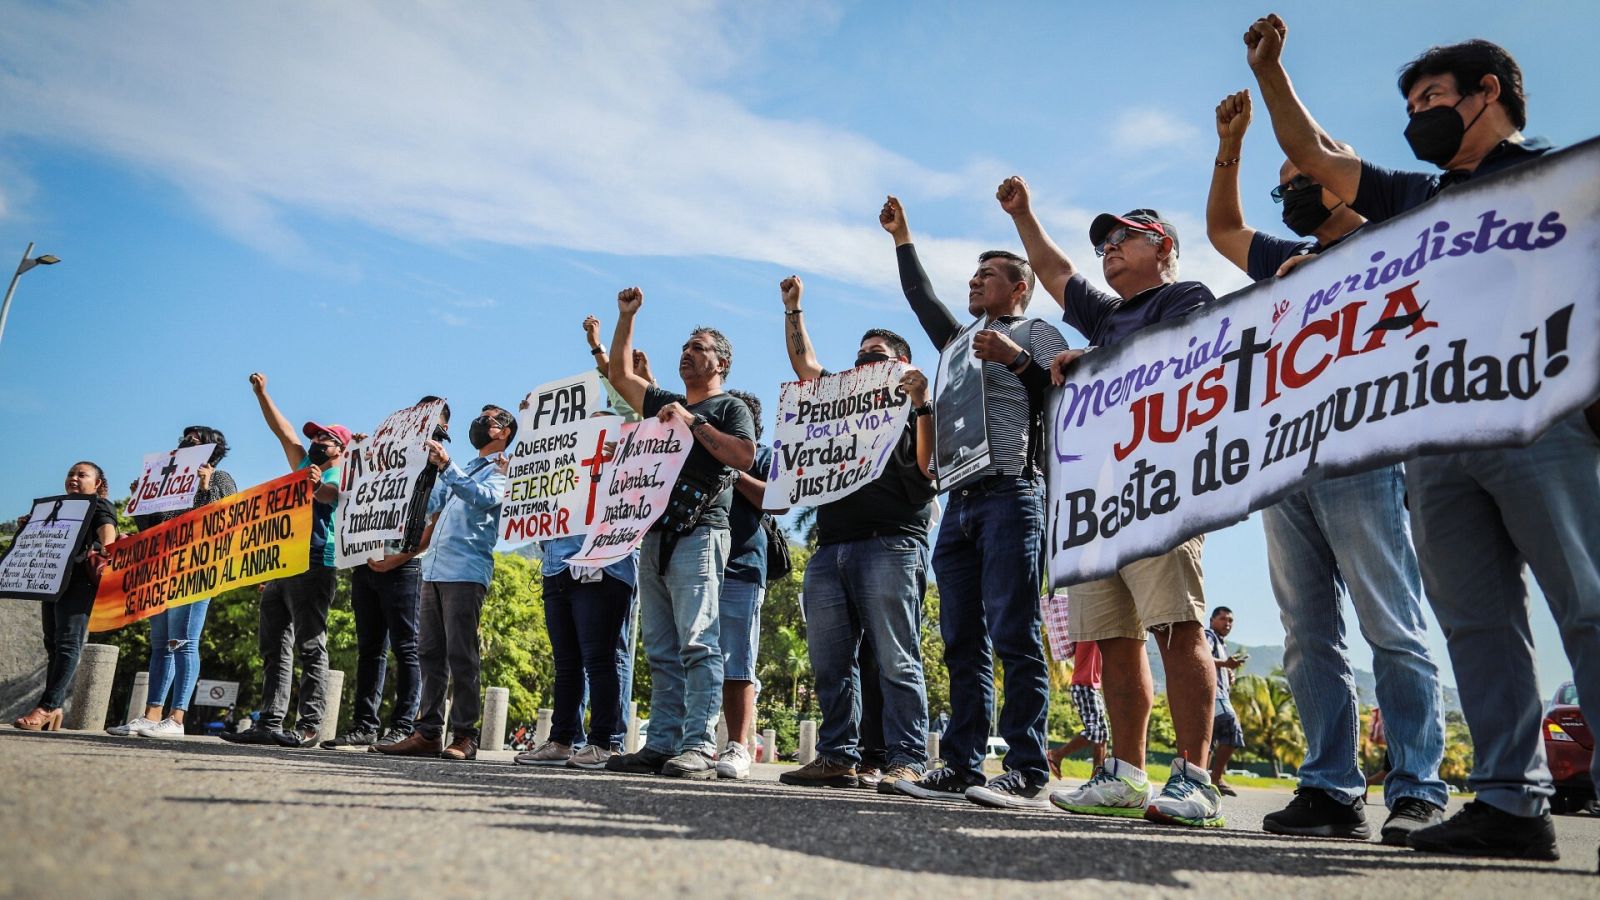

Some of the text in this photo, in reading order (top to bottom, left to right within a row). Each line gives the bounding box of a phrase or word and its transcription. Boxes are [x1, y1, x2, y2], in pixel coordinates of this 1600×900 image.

[1056, 209, 1568, 434] Memorial de periodistas
[1113, 280, 1438, 462] JUSTICIA
[533, 385, 586, 430] FGR
[795, 385, 907, 425] PERIODISTAS
[515, 432, 578, 457] QUEREMOS
[643, 429, 682, 454] mata
[805, 410, 894, 442] POR LA VIDA
[1051, 303, 1575, 559] ¡Basta de impunidad!
[509, 453, 576, 479] LIBERTAD PARA
[769, 434, 857, 482] ¡Verdad
[609, 468, 619, 496] la
[150, 532, 161, 557] DE
[166, 523, 194, 549] NADA
[201, 512, 226, 539] NOS
[227, 496, 262, 529] SIRVE
[265, 480, 311, 516] REZAR.
[348, 502, 407, 534] matando!
[502, 504, 519, 518] SIN
[520, 501, 549, 515] TEMOR
[504, 507, 570, 541] MORIR
[601, 495, 652, 525] matando
[122, 514, 295, 593] CAMINANTE NO HAY CAMINO.
[124, 545, 287, 616] SE HACE CAMINO AL ANDAR.
